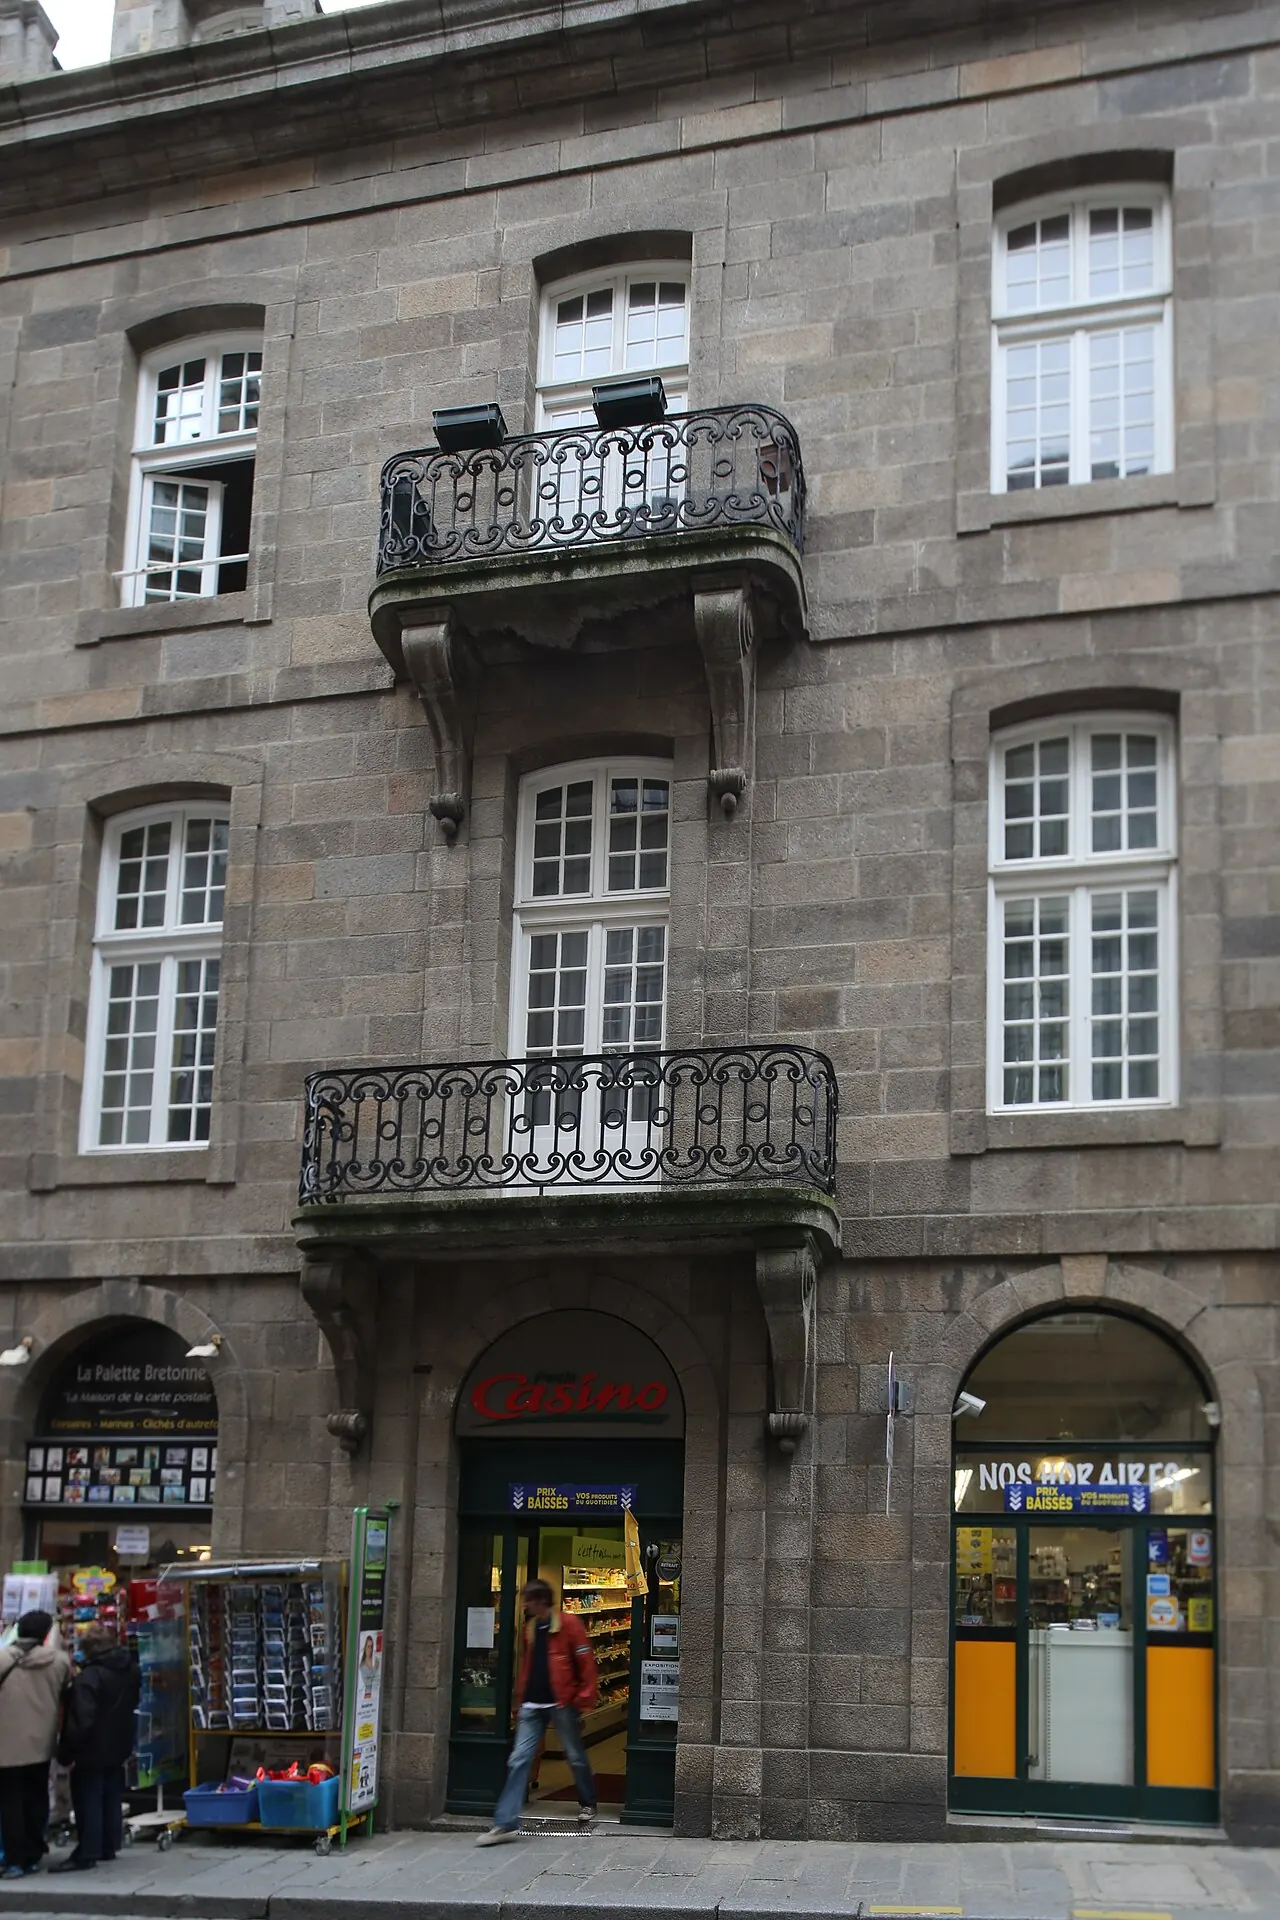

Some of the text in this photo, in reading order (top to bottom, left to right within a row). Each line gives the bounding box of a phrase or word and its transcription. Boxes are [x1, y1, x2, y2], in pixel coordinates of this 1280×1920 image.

[77, 1363, 206, 1382] La Palette Bretonne
[79, 1391, 115, 1403] Maison
[117, 1391, 131, 1403] de
[133, 1391, 143, 1403] la
[145, 1391, 172, 1403] carte
[471, 1372, 668, 1420] Casino
[979, 1462, 1181, 1492] NOS HORAIRES
[536, 1487, 557, 1496] PRIX
[575, 1492, 591, 1500] VOS
[1035, 1486, 1059, 1496] PRIX
[1080, 1492, 1097, 1500] VOS
[527, 1494, 569, 1510] BAISSÉS
[1025, 1494, 1074, 1511] BAISSÉS
